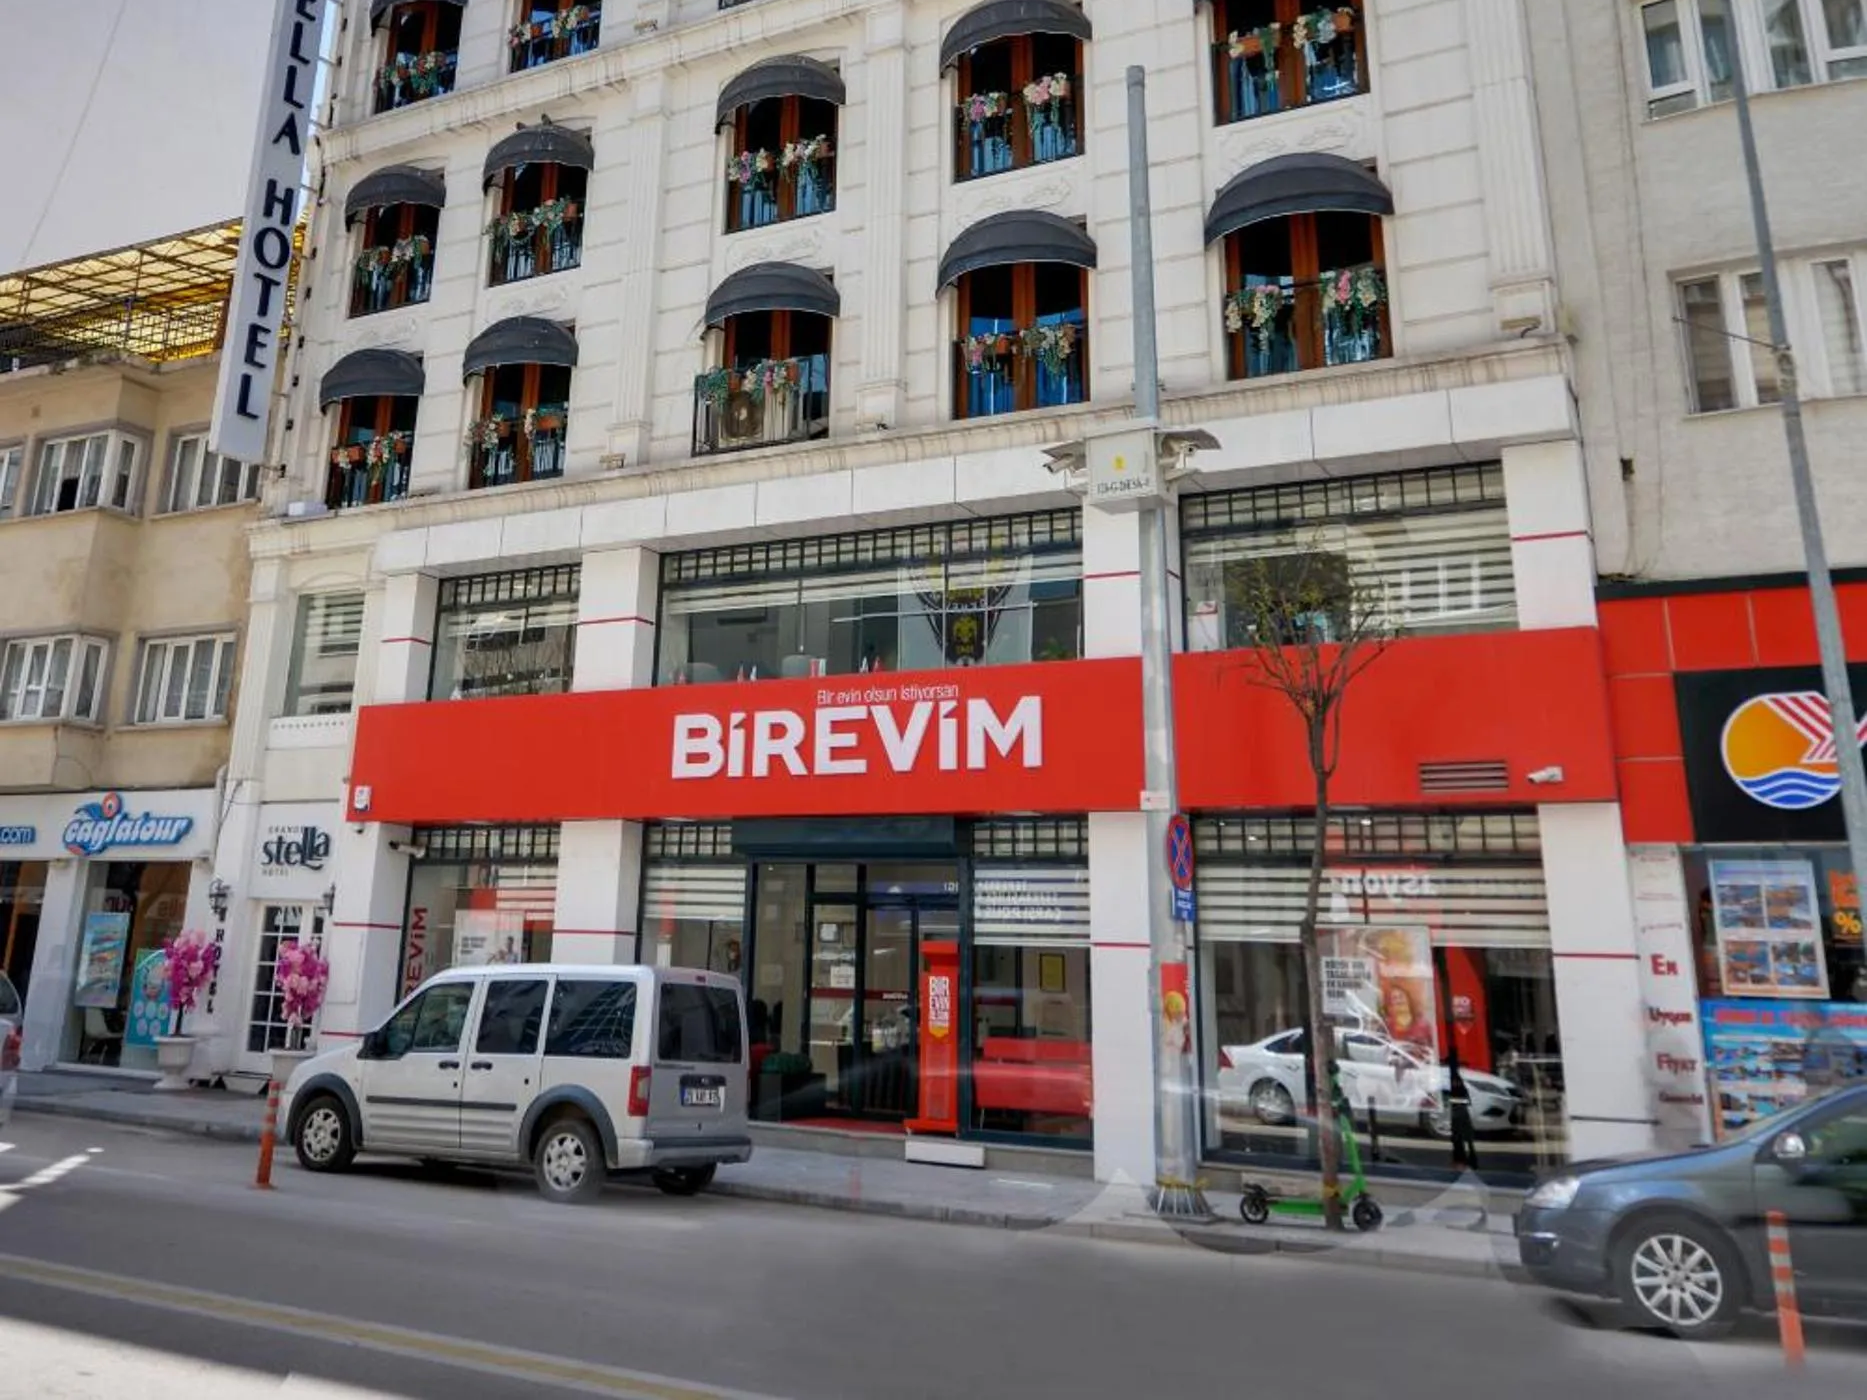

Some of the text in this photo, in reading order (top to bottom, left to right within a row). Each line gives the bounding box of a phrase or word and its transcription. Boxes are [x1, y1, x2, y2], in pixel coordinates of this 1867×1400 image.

[237, 178, 294, 420] HOTEL
[817, 688, 835, 704] Bir
[837, 687, 862, 703] evin
[864, 684, 897, 702] olsun
